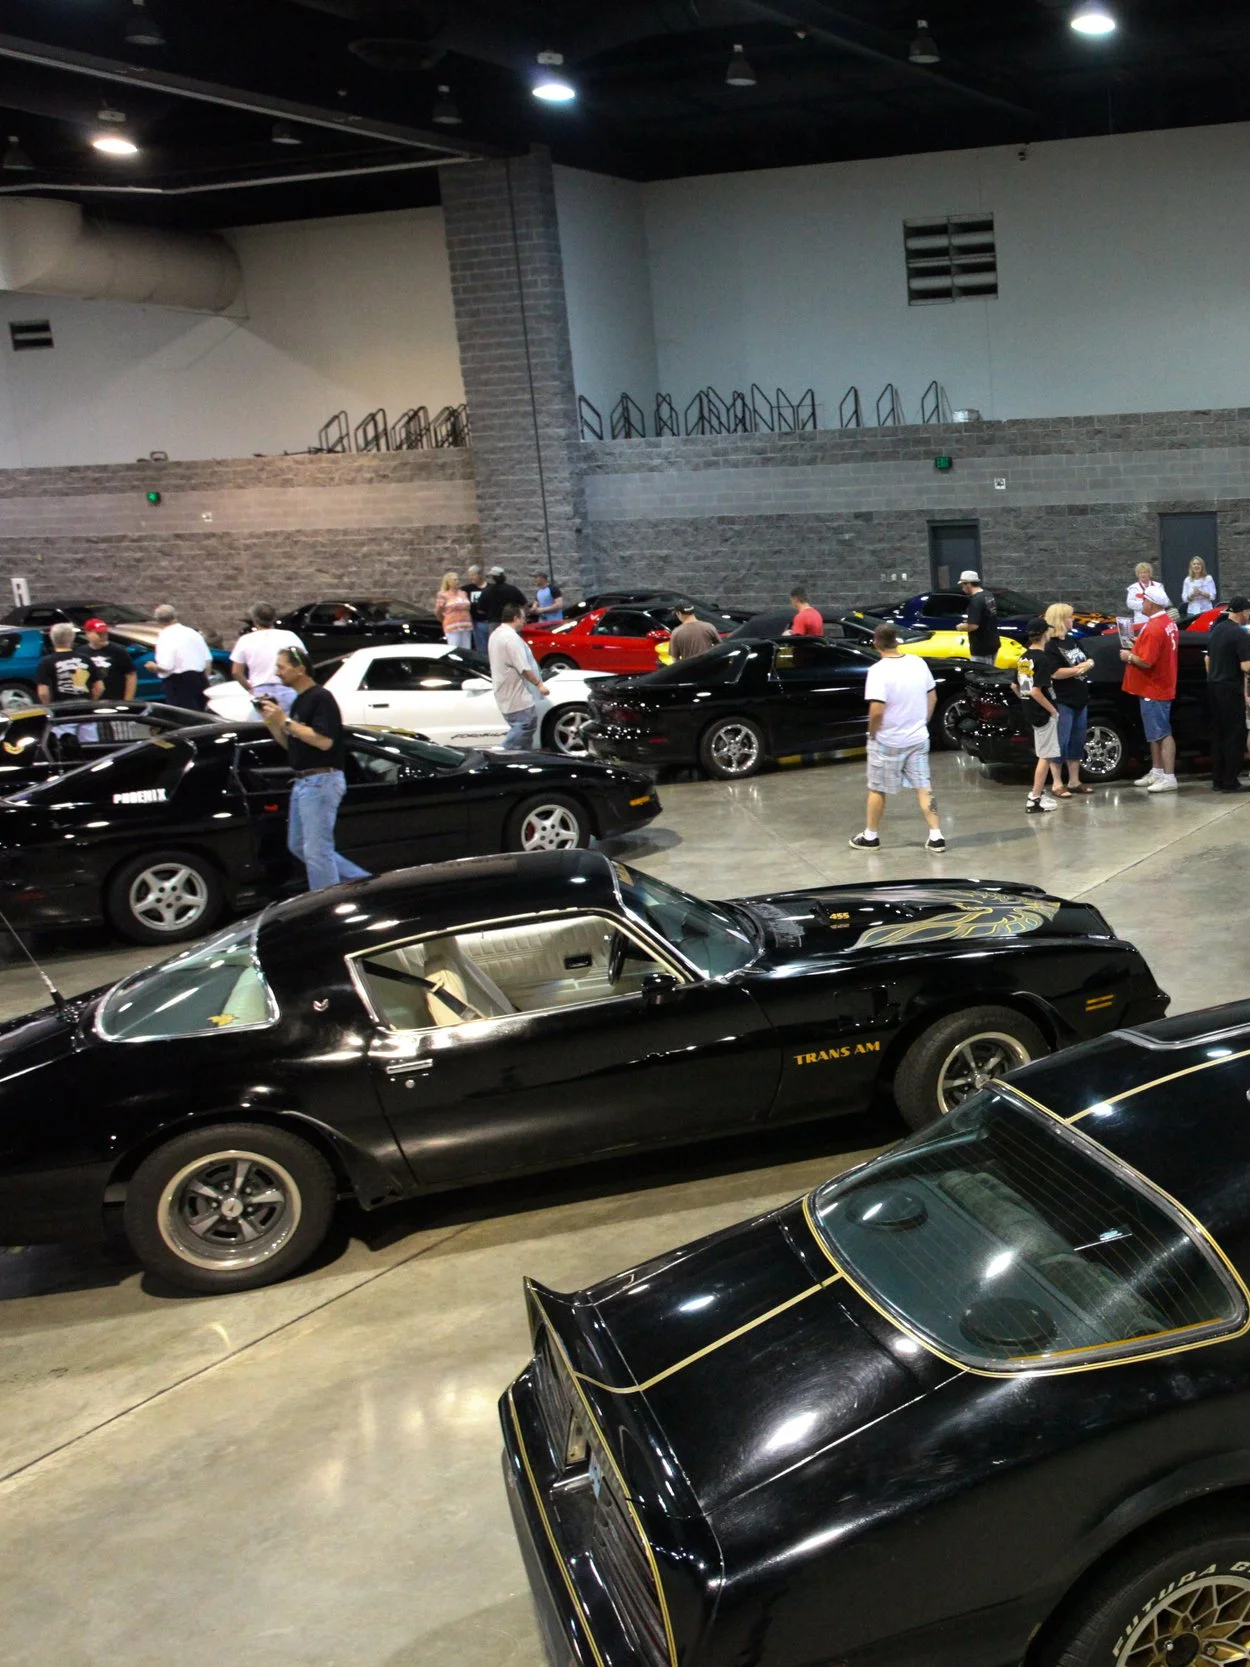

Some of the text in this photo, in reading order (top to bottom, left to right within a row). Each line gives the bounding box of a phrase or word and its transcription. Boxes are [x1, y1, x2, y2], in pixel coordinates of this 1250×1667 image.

[793, 1041, 880, 1065] TRANS AM
[1112, 1564, 1217, 1657] FUTURA
